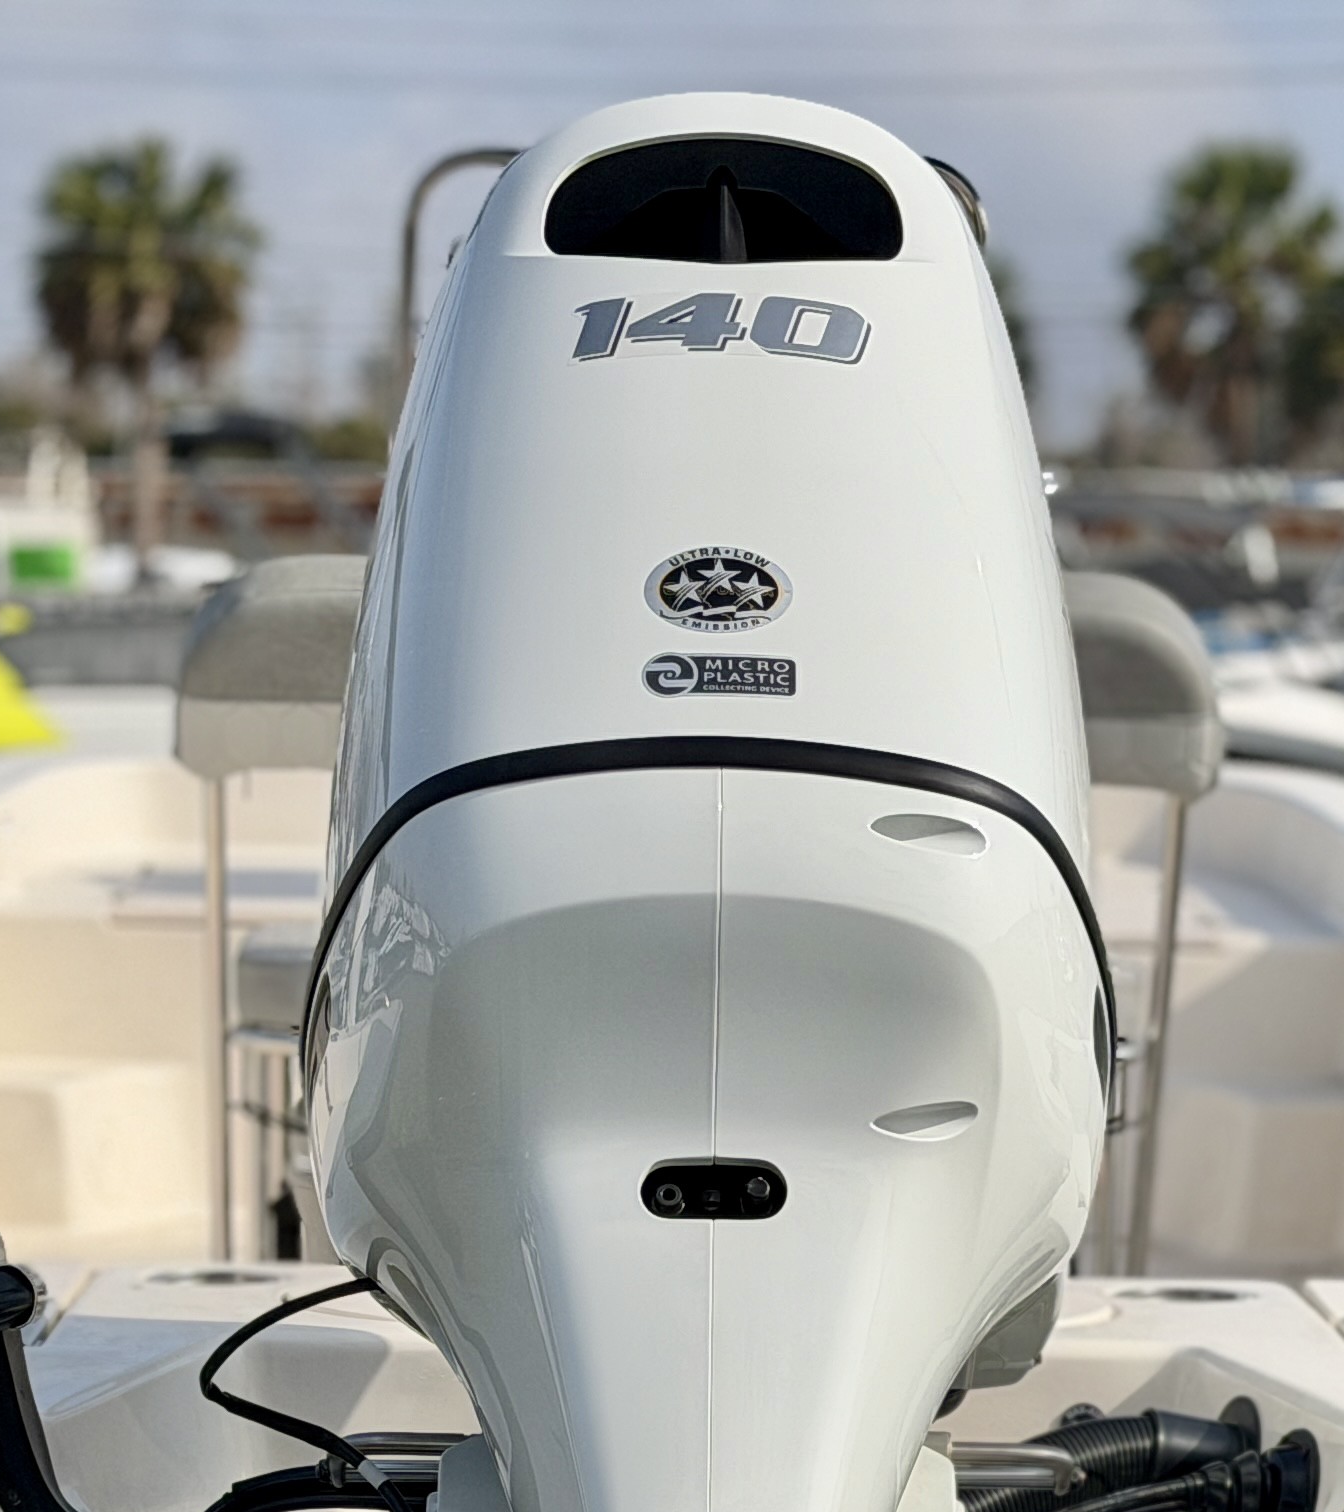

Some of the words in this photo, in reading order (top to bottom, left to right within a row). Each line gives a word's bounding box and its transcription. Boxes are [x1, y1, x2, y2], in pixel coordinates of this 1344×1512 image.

[572, 293, 871, 364] 140
[668, 547, 722, 568] ULTRA
[733, 549, 771, 568] LOW
[680, 617, 761, 631] EMISSION
[705, 659, 790, 673] MICRO
[703, 671, 790, 686] PLASTIC
[702, 684, 757, 692] COLLECTING
[759, 685, 790, 694] DEVICE
